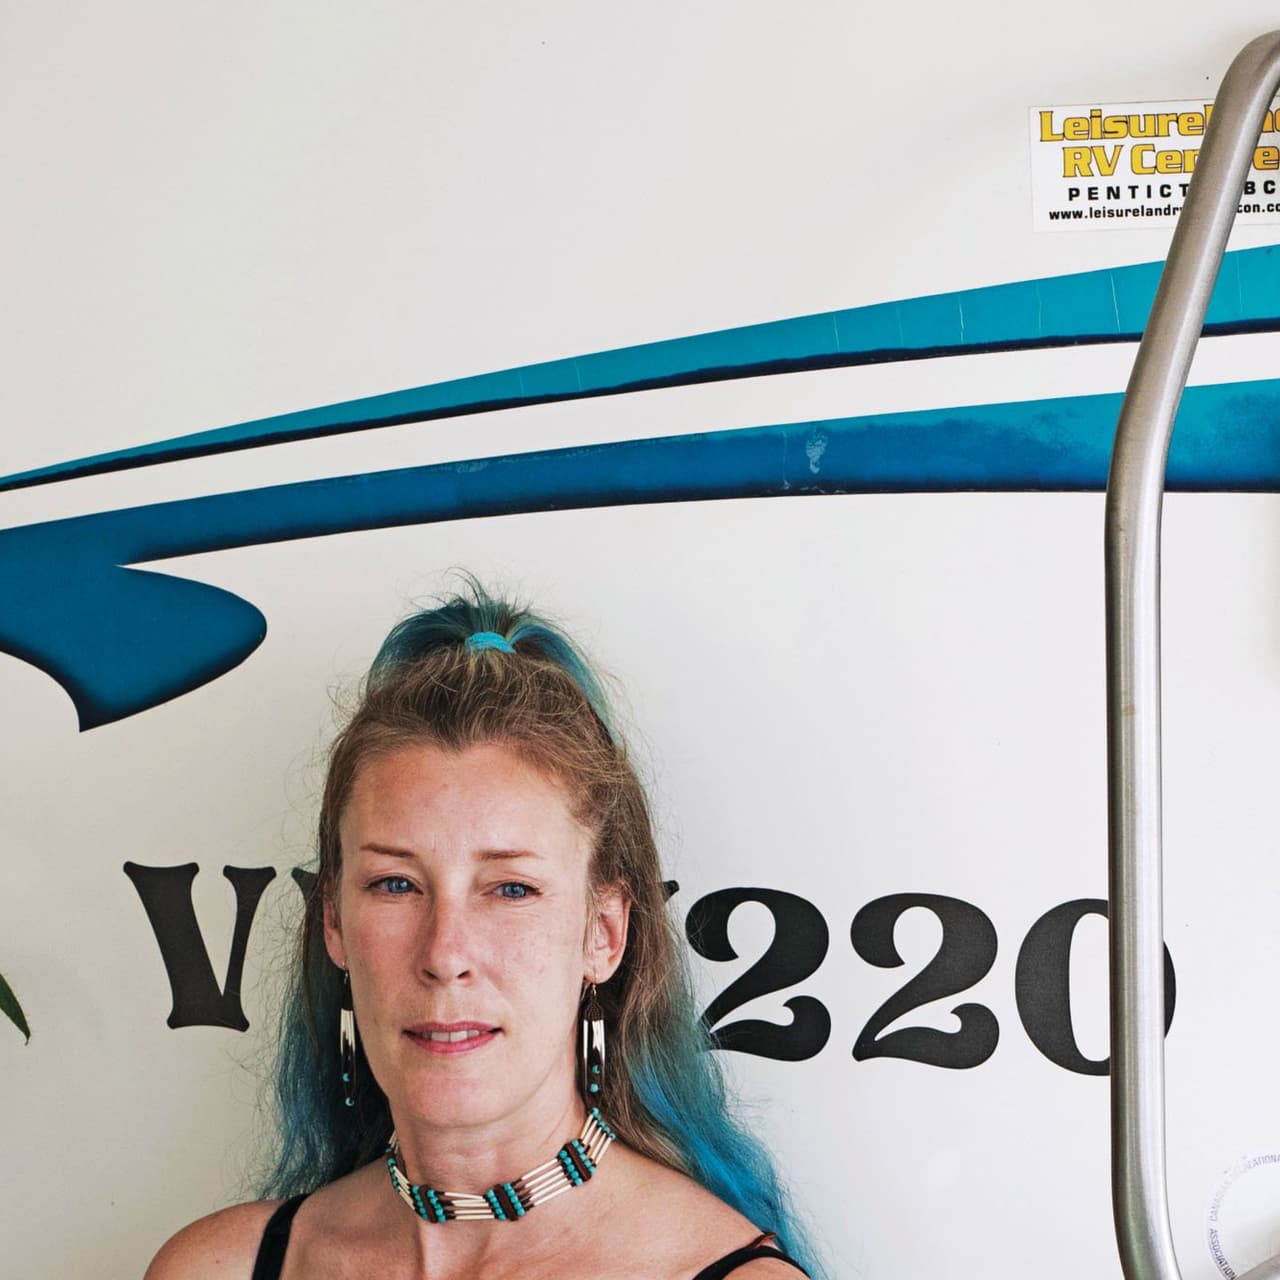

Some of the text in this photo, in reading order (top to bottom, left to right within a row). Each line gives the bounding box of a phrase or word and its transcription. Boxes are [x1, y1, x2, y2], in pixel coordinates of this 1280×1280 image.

[1062, 143, 1280, 178] RV Cene
[1068, 183, 1191, 201] PENTICT
